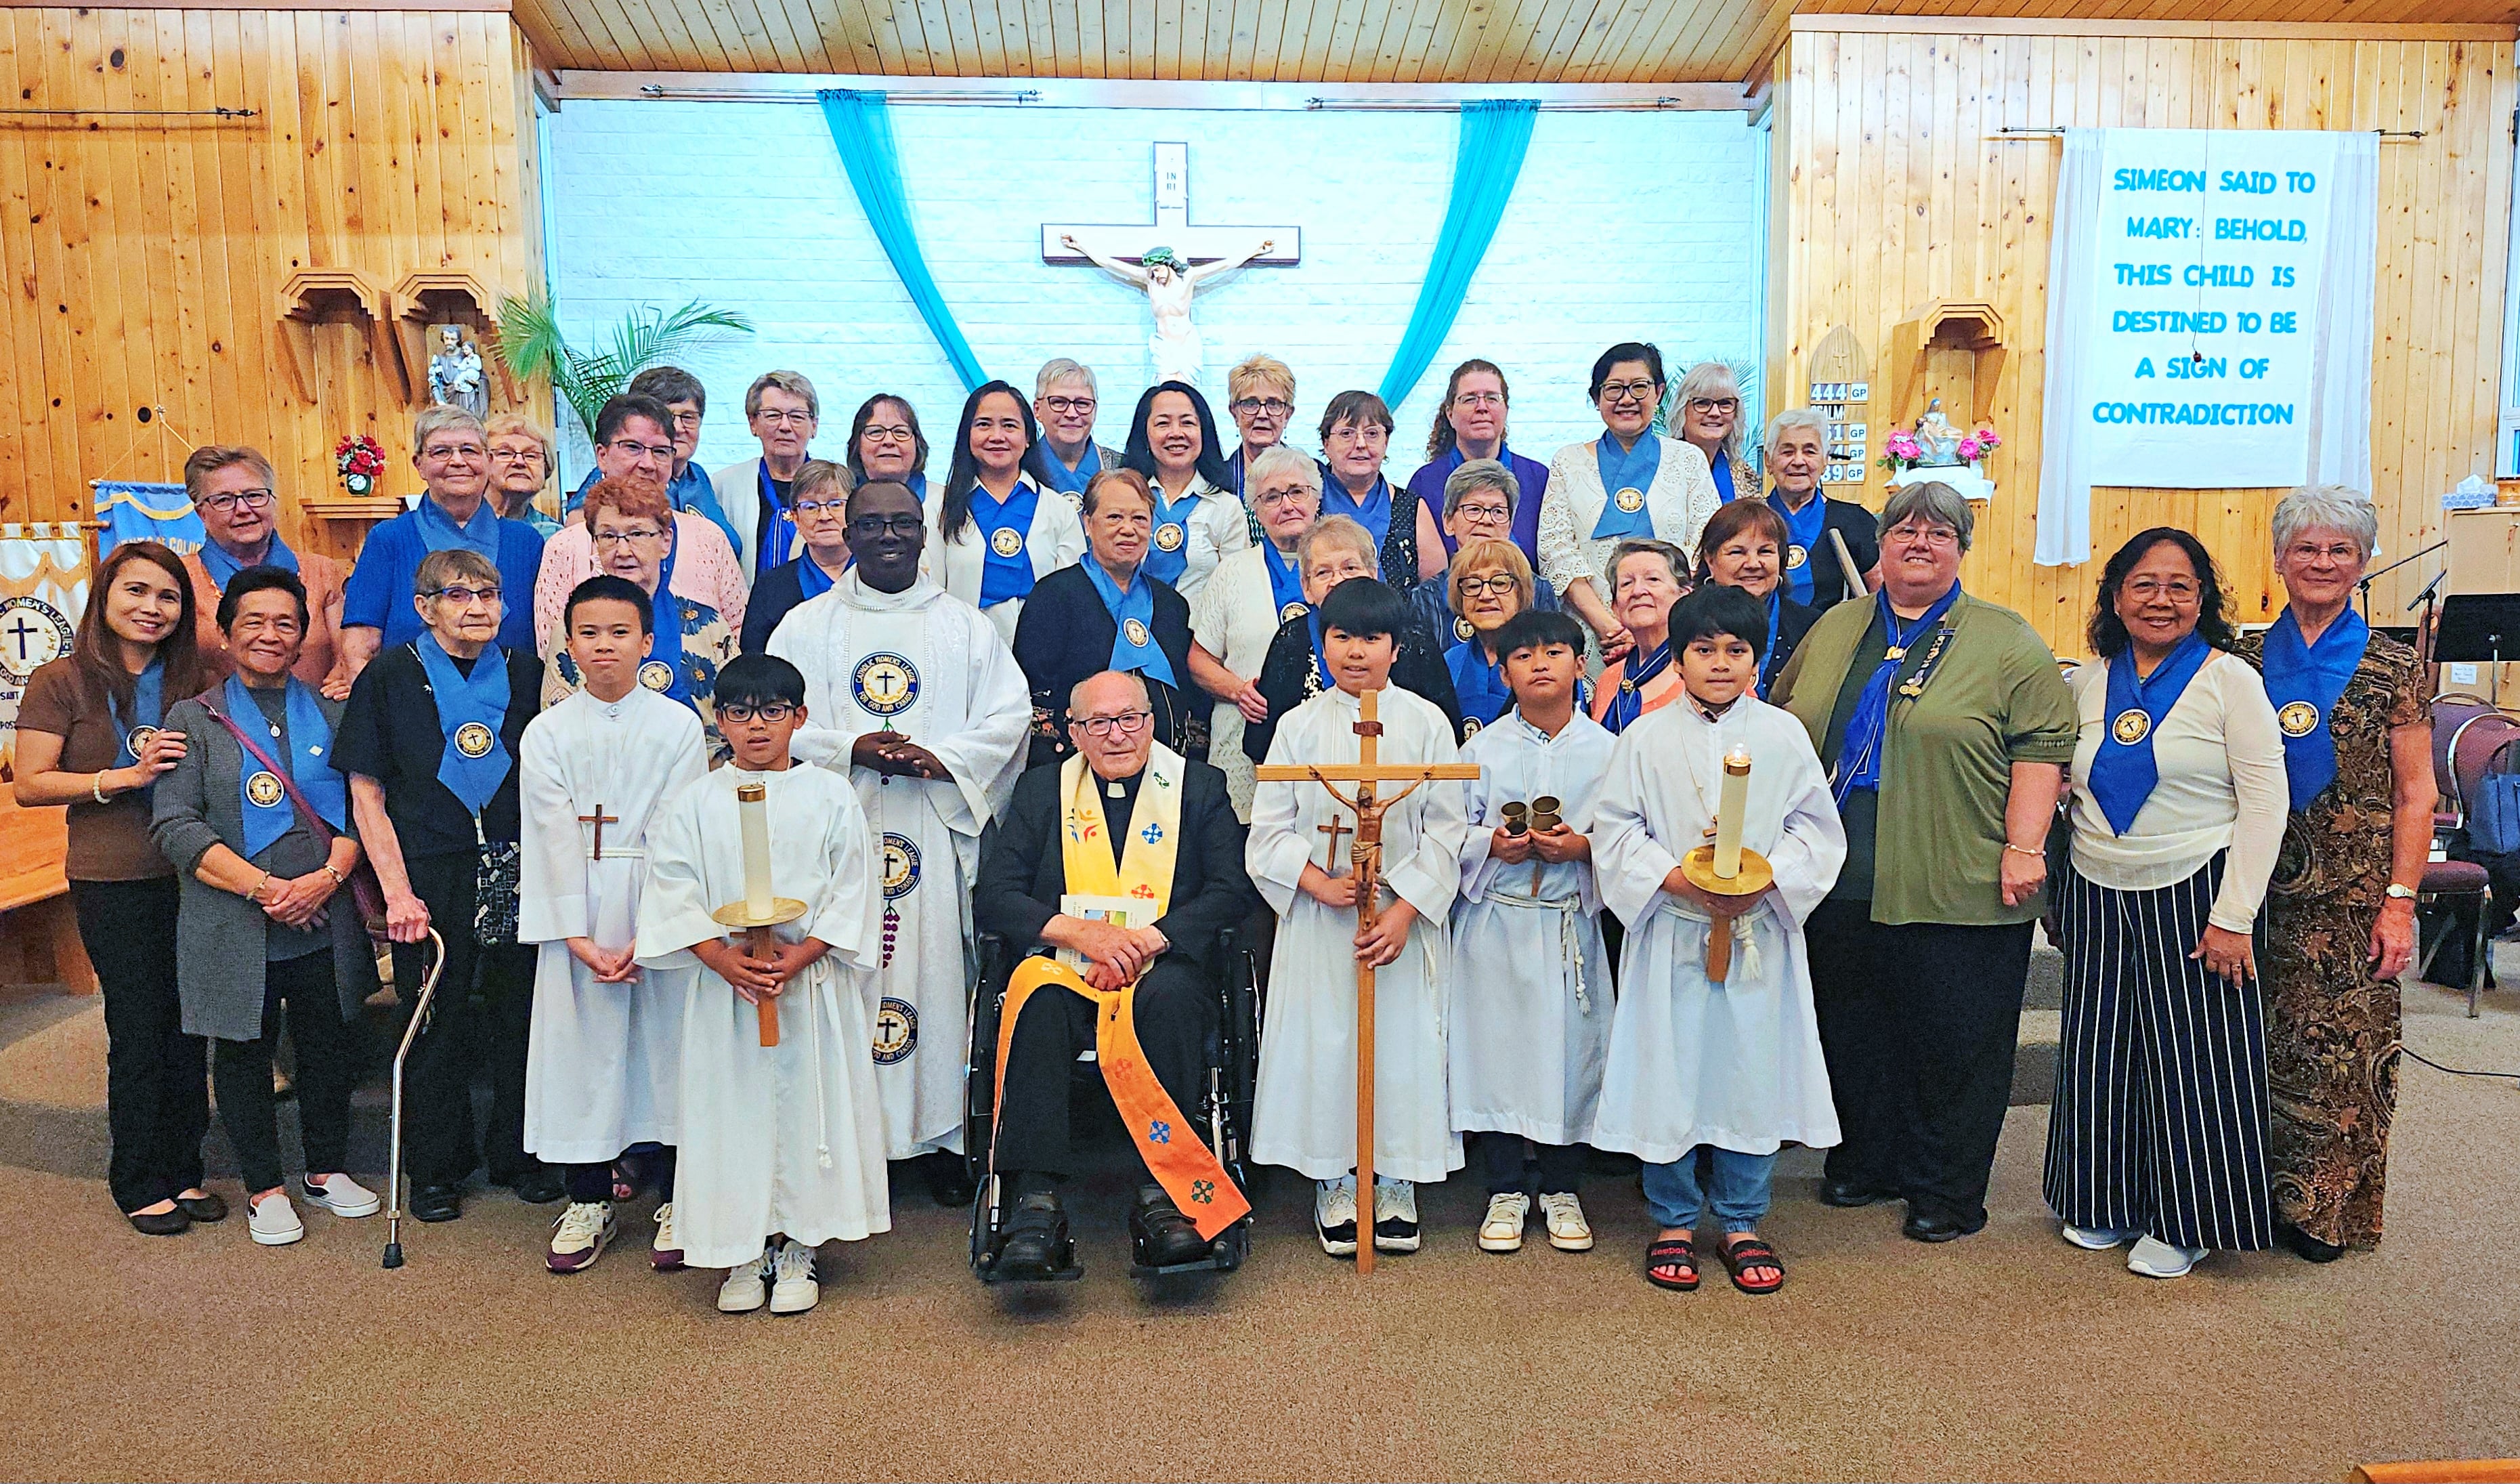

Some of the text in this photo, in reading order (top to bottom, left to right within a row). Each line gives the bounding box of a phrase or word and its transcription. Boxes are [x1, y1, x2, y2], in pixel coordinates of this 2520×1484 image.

[2114, 168, 2316, 195] SIMEON SAID TO
[2127, 216, 2307, 245] MARY: BEHOLD,
[2114, 263, 2295, 288] THIS CHILD IS
[2112, 310, 2297, 333] DESTINED TO BE
[2134, 356, 2269, 380] A SIGN OF
[1811, 383, 1866, 401] 444 GP
[2092, 402, 2294, 426] CONTRADICTION
[1850, 429, 1865, 438] GP
[1848, 469, 1863, 478] GP
[857, 691, 915, 713] FOR GOD AND CANADA
